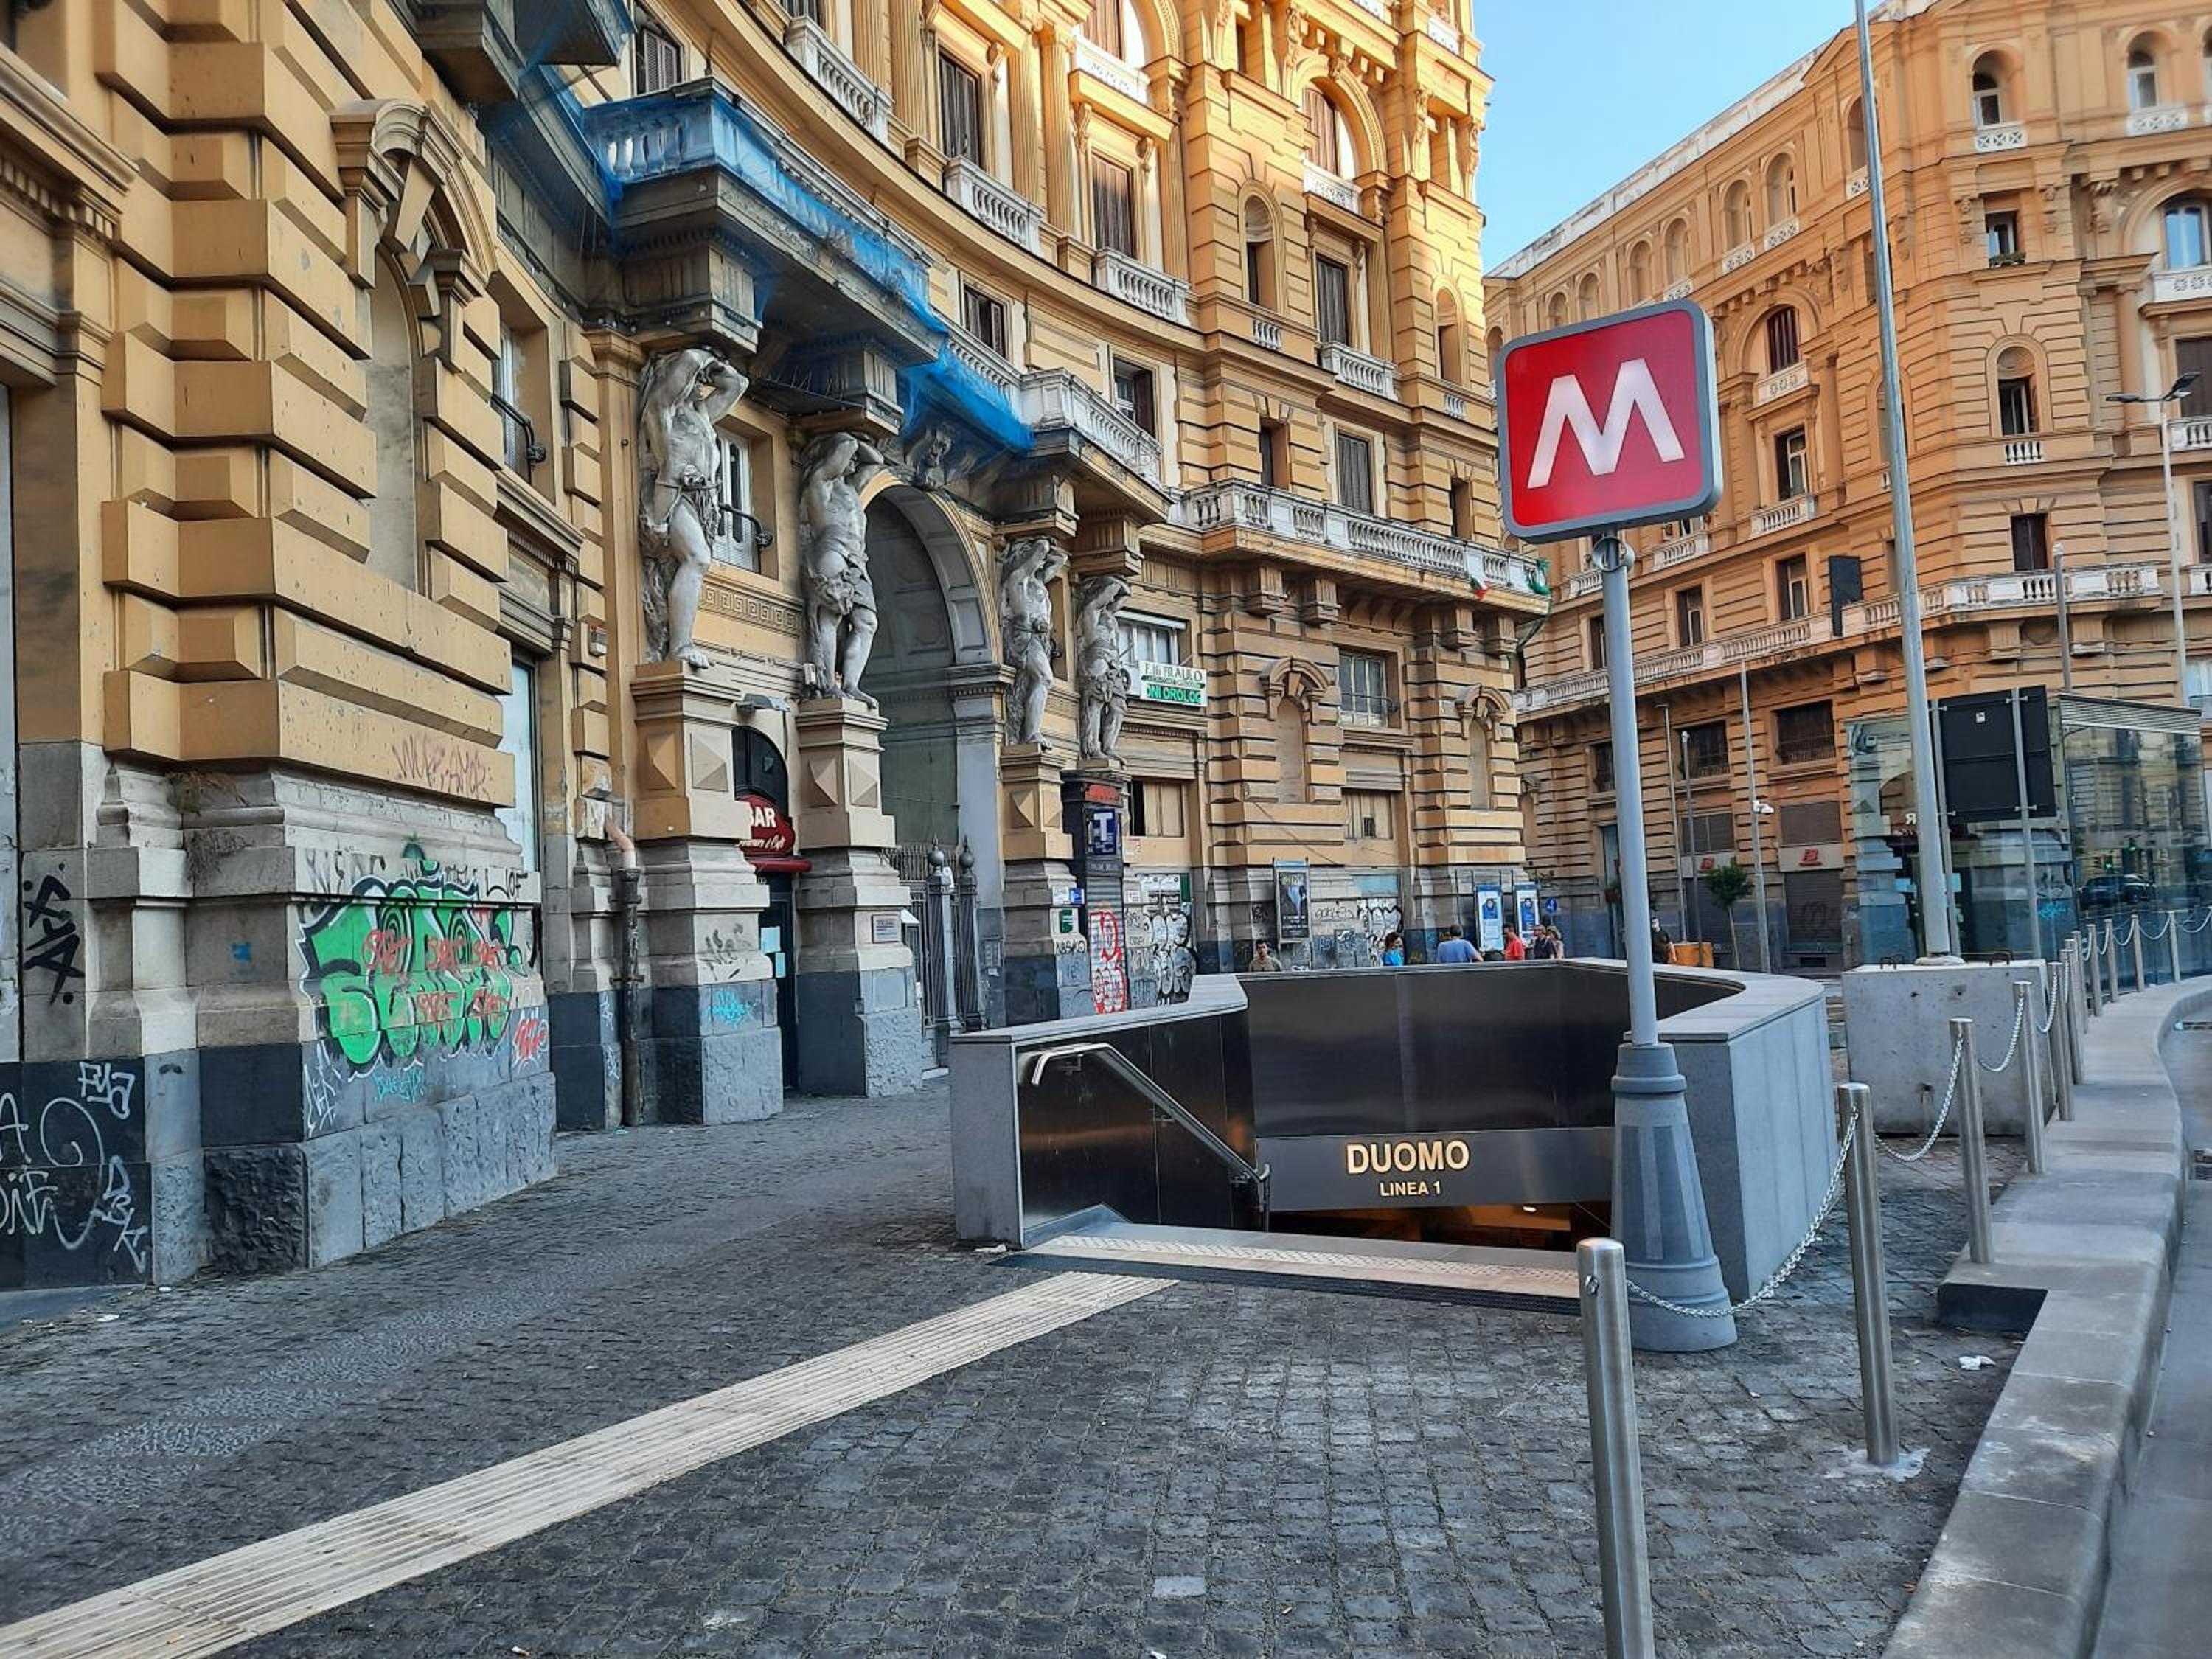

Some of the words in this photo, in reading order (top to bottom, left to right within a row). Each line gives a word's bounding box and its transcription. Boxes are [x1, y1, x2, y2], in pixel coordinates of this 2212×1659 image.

[1527, 358, 1686, 490] M
[1347, 1141, 1470, 1174] DUOMO
[1380, 1181, 1430, 1197] LINEA
[1433, 1180, 1441, 1195] 1
